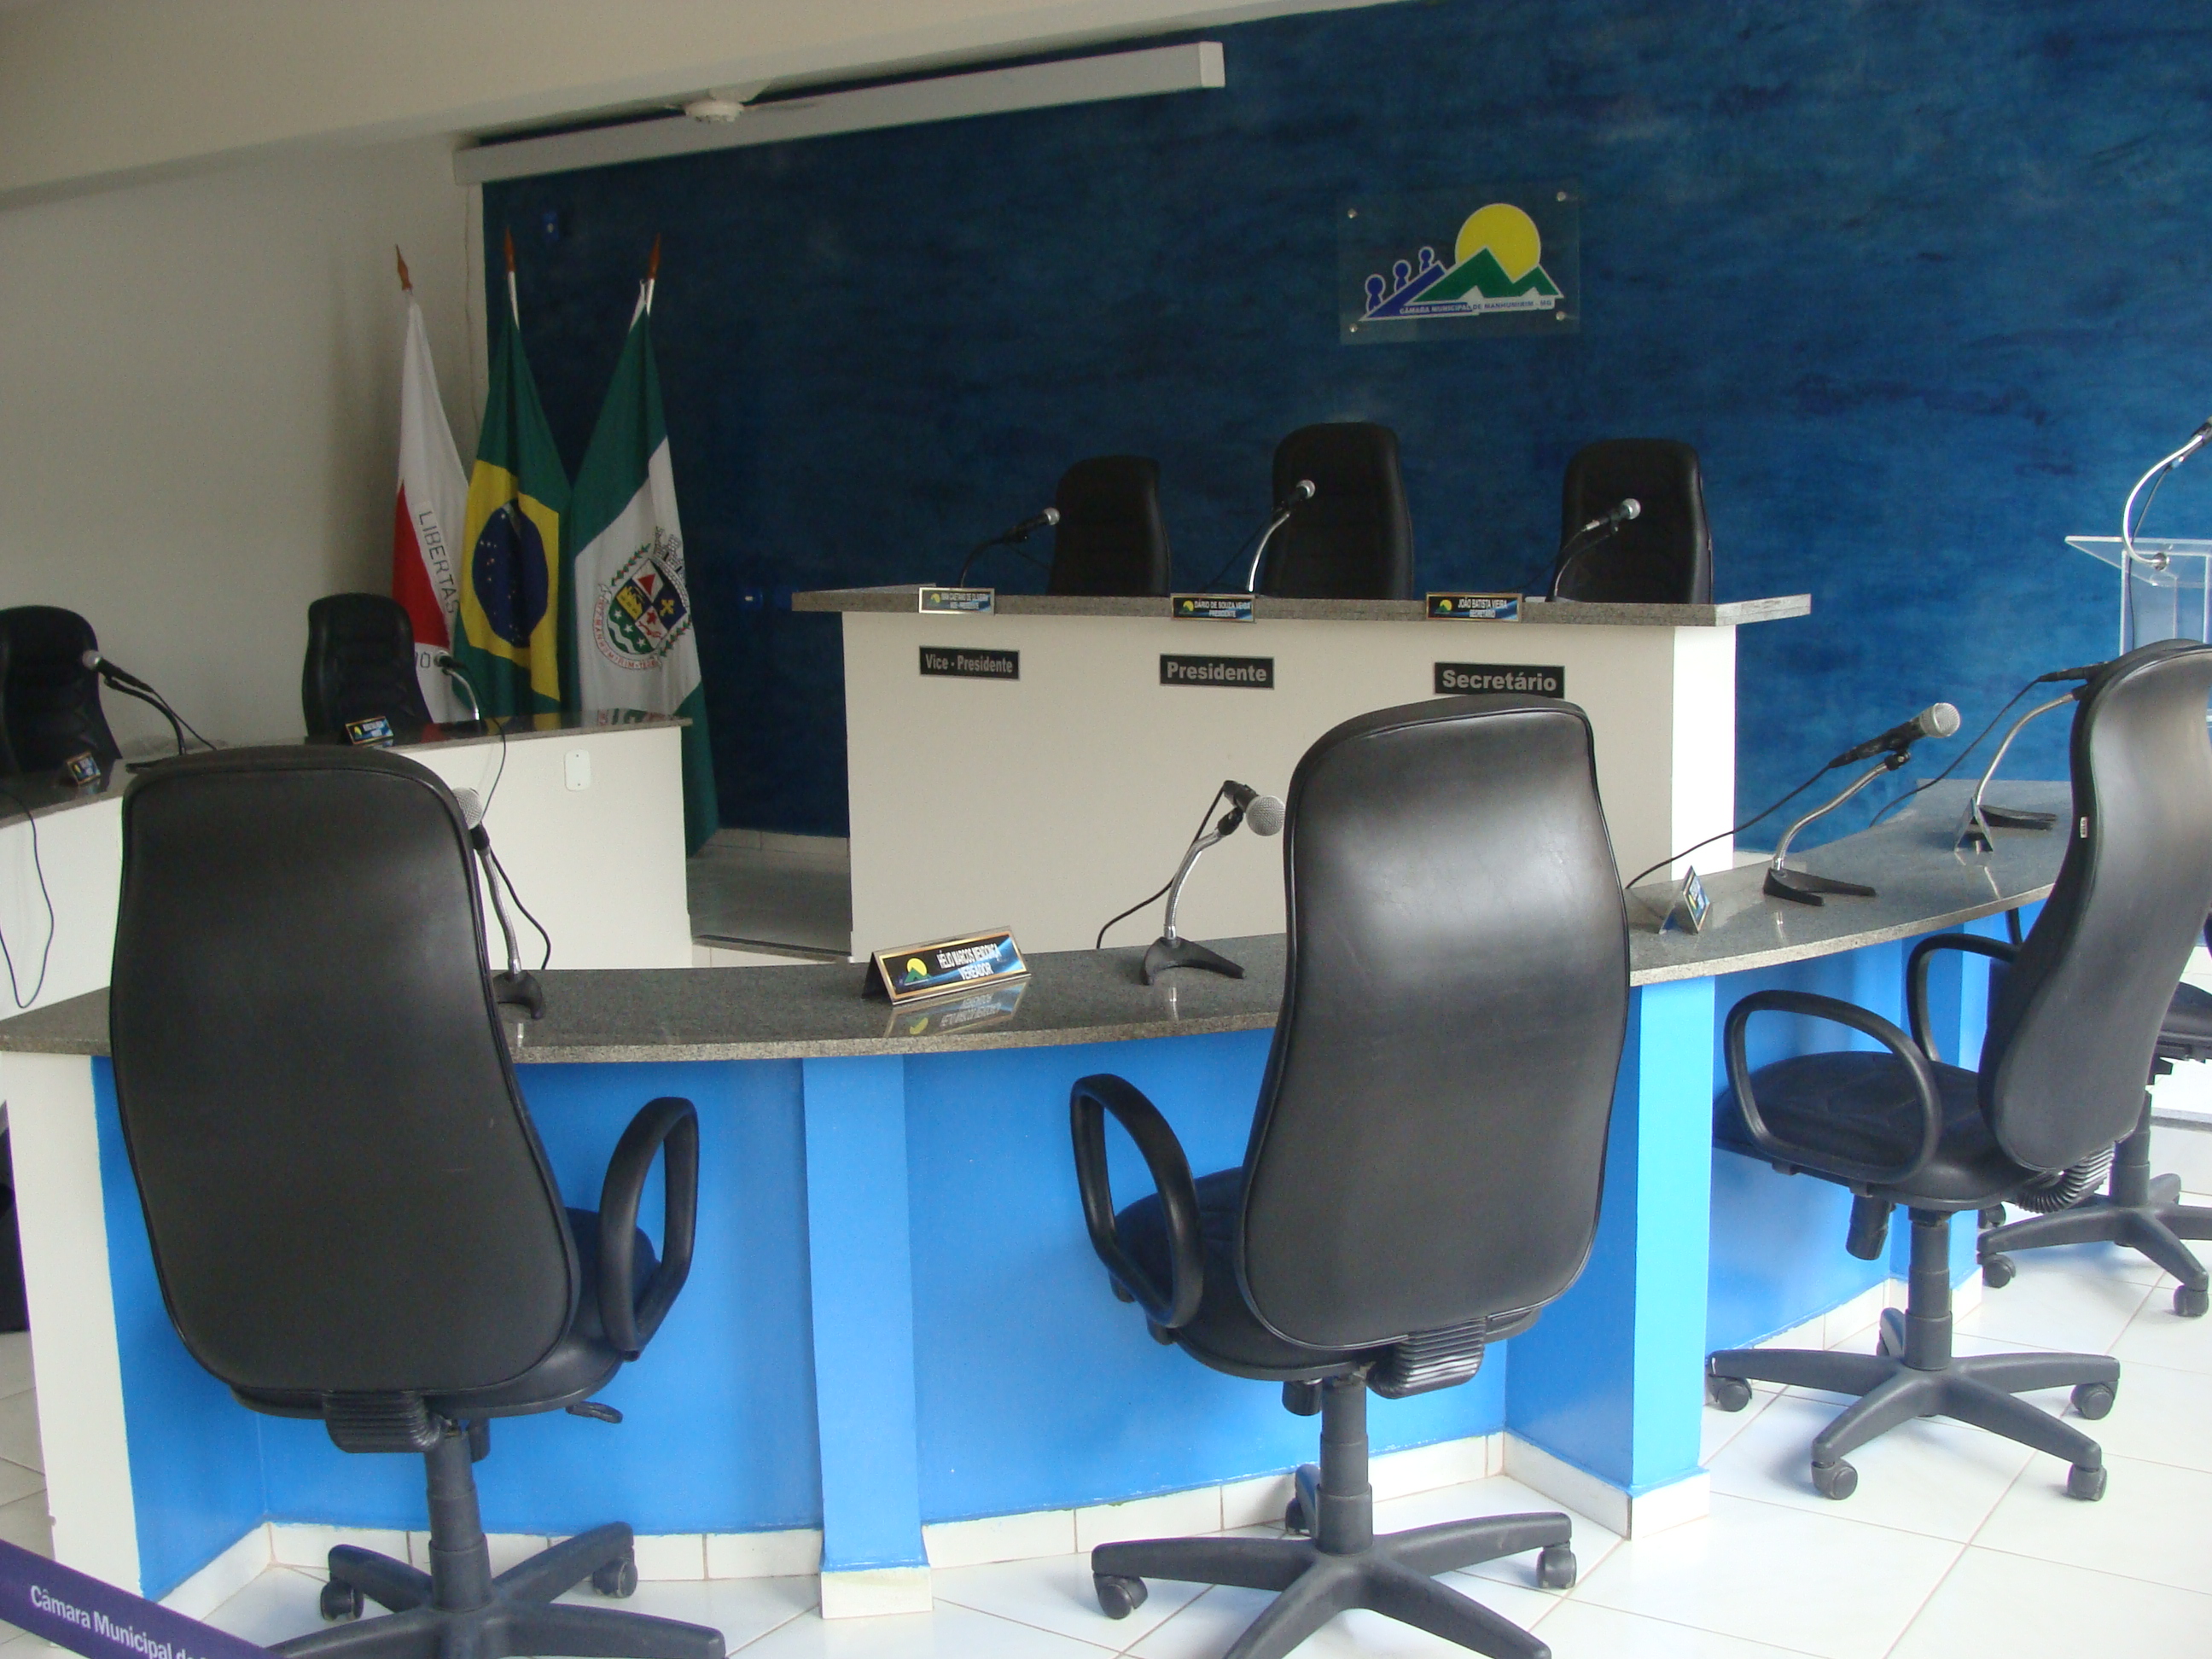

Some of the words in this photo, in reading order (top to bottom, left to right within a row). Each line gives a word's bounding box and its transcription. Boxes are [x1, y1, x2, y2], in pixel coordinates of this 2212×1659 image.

[419, 511, 460, 614] LIBERTAS
[1218, 601, 1236, 609] SOUZA
[1458, 597, 1472, 608] JOÃO
[1471, 598, 1492, 608] BATISTA
[925, 654, 949, 670] Vice
[957, 655, 1013, 673] Presidente
[1167, 661, 1267, 682] Presidente
[1442, 669, 1557, 692] Secretário
[936, 949, 956, 969] HÉLIO
[952, 947, 975, 966] MARCOS
[958, 962, 995, 980] VEREADOR
[30, 1585, 91, 1628] Câmara
[93, 1610, 172, 1659] Municipal
